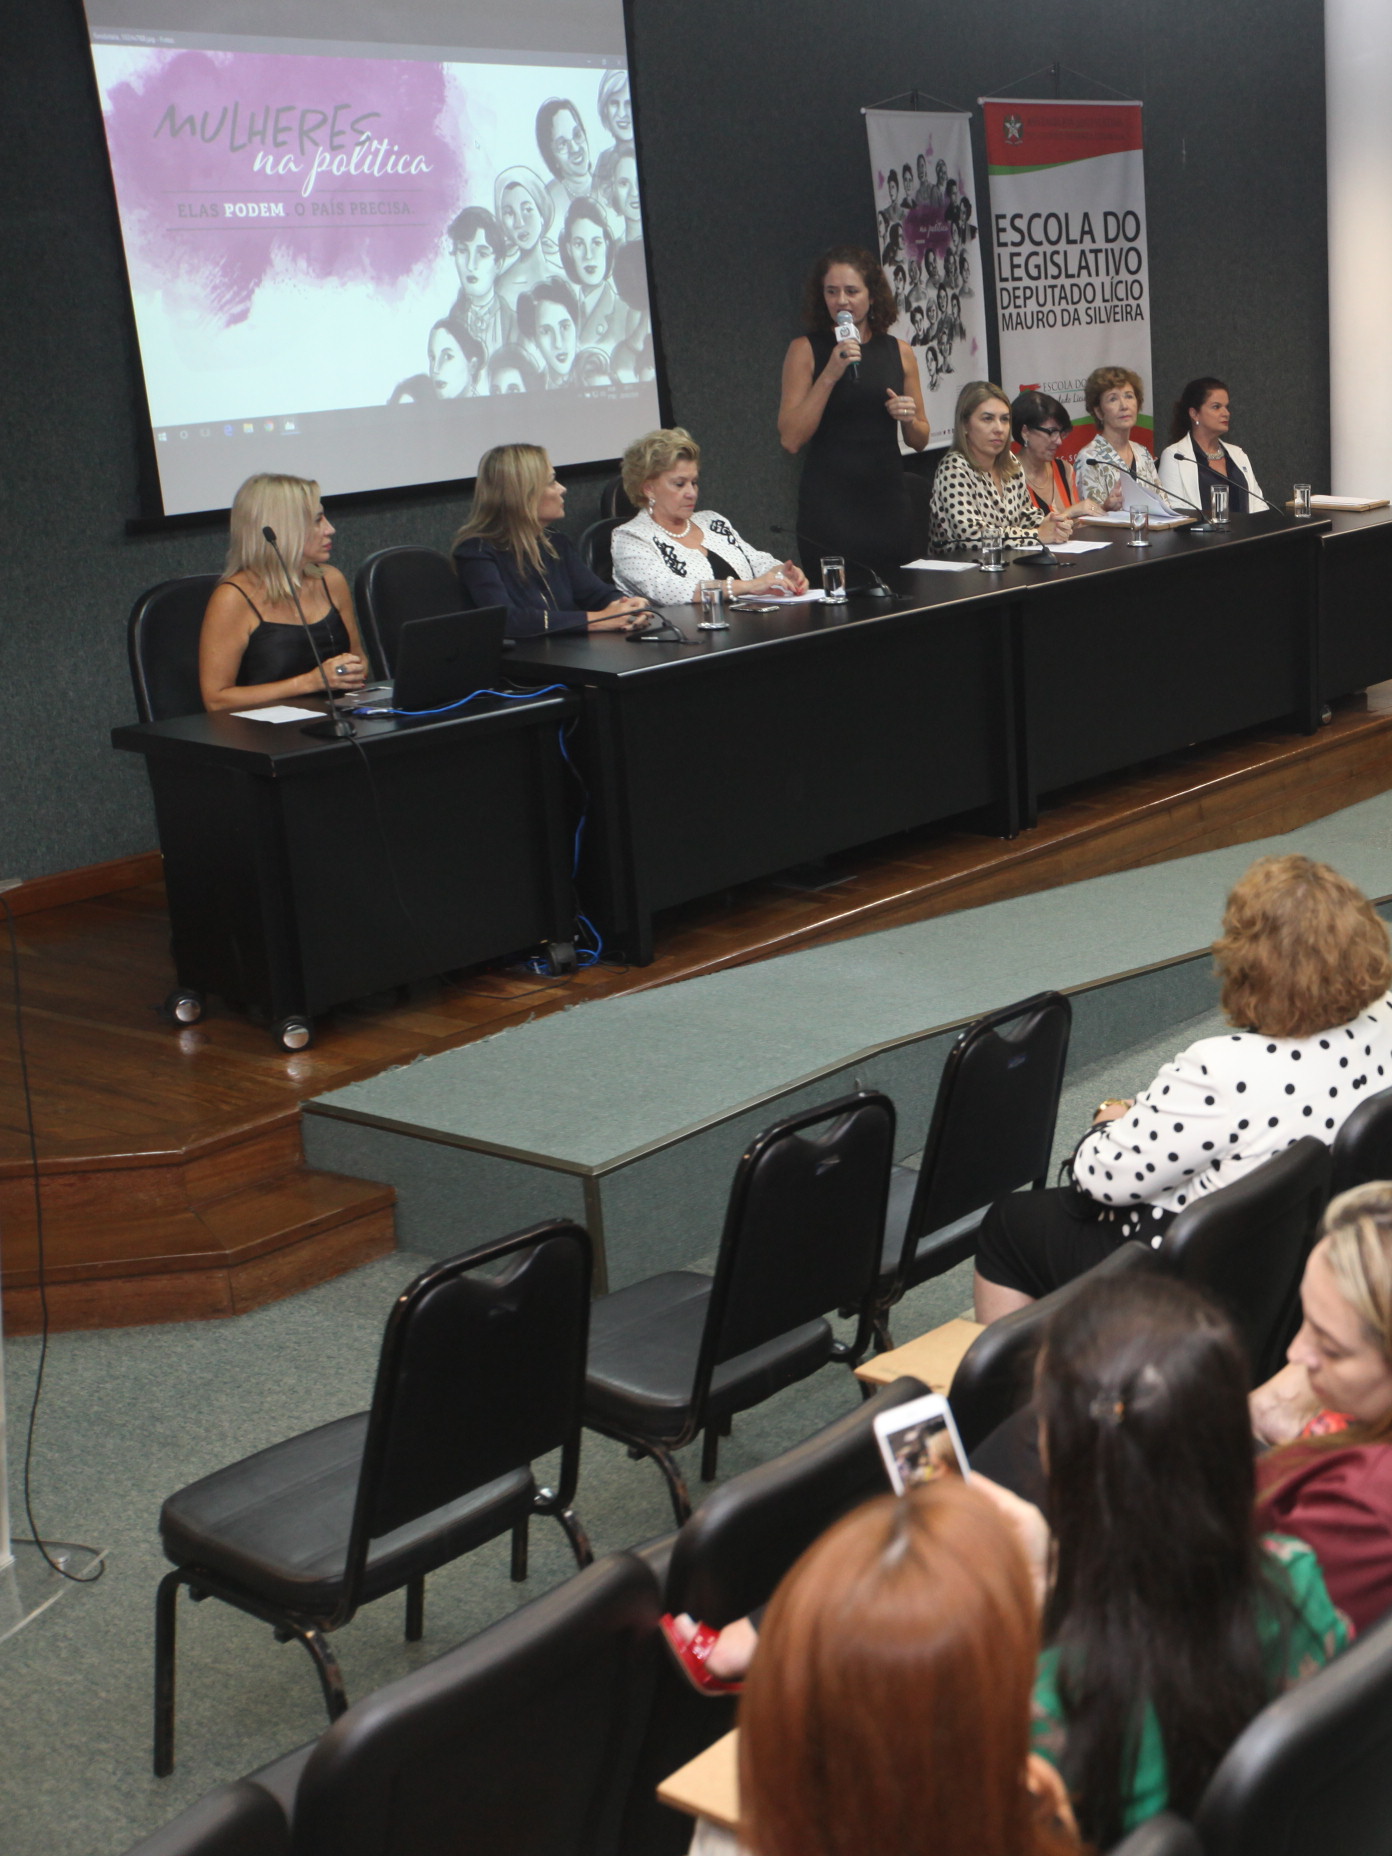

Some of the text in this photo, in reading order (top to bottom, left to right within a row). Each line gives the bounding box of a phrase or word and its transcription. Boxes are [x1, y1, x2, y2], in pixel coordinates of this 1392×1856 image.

[153, 100, 382, 155] MULHERES
[252, 131, 434, 198] na política
[177, 203, 219, 218] ELAS
[294, 203, 306, 216] O
[311, 200, 345, 216] PAÍS
[994, 210, 1141, 248] ESCOLA DO
[997, 246, 1143, 283] LEGISLATIVO
[999, 275, 1144, 310] DEPUTADO LÍCIO
[1001, 303, 1145, 332] MAURO DA SILVEIRA
[1042, 378, 1088, 392] ESCOLA DO
